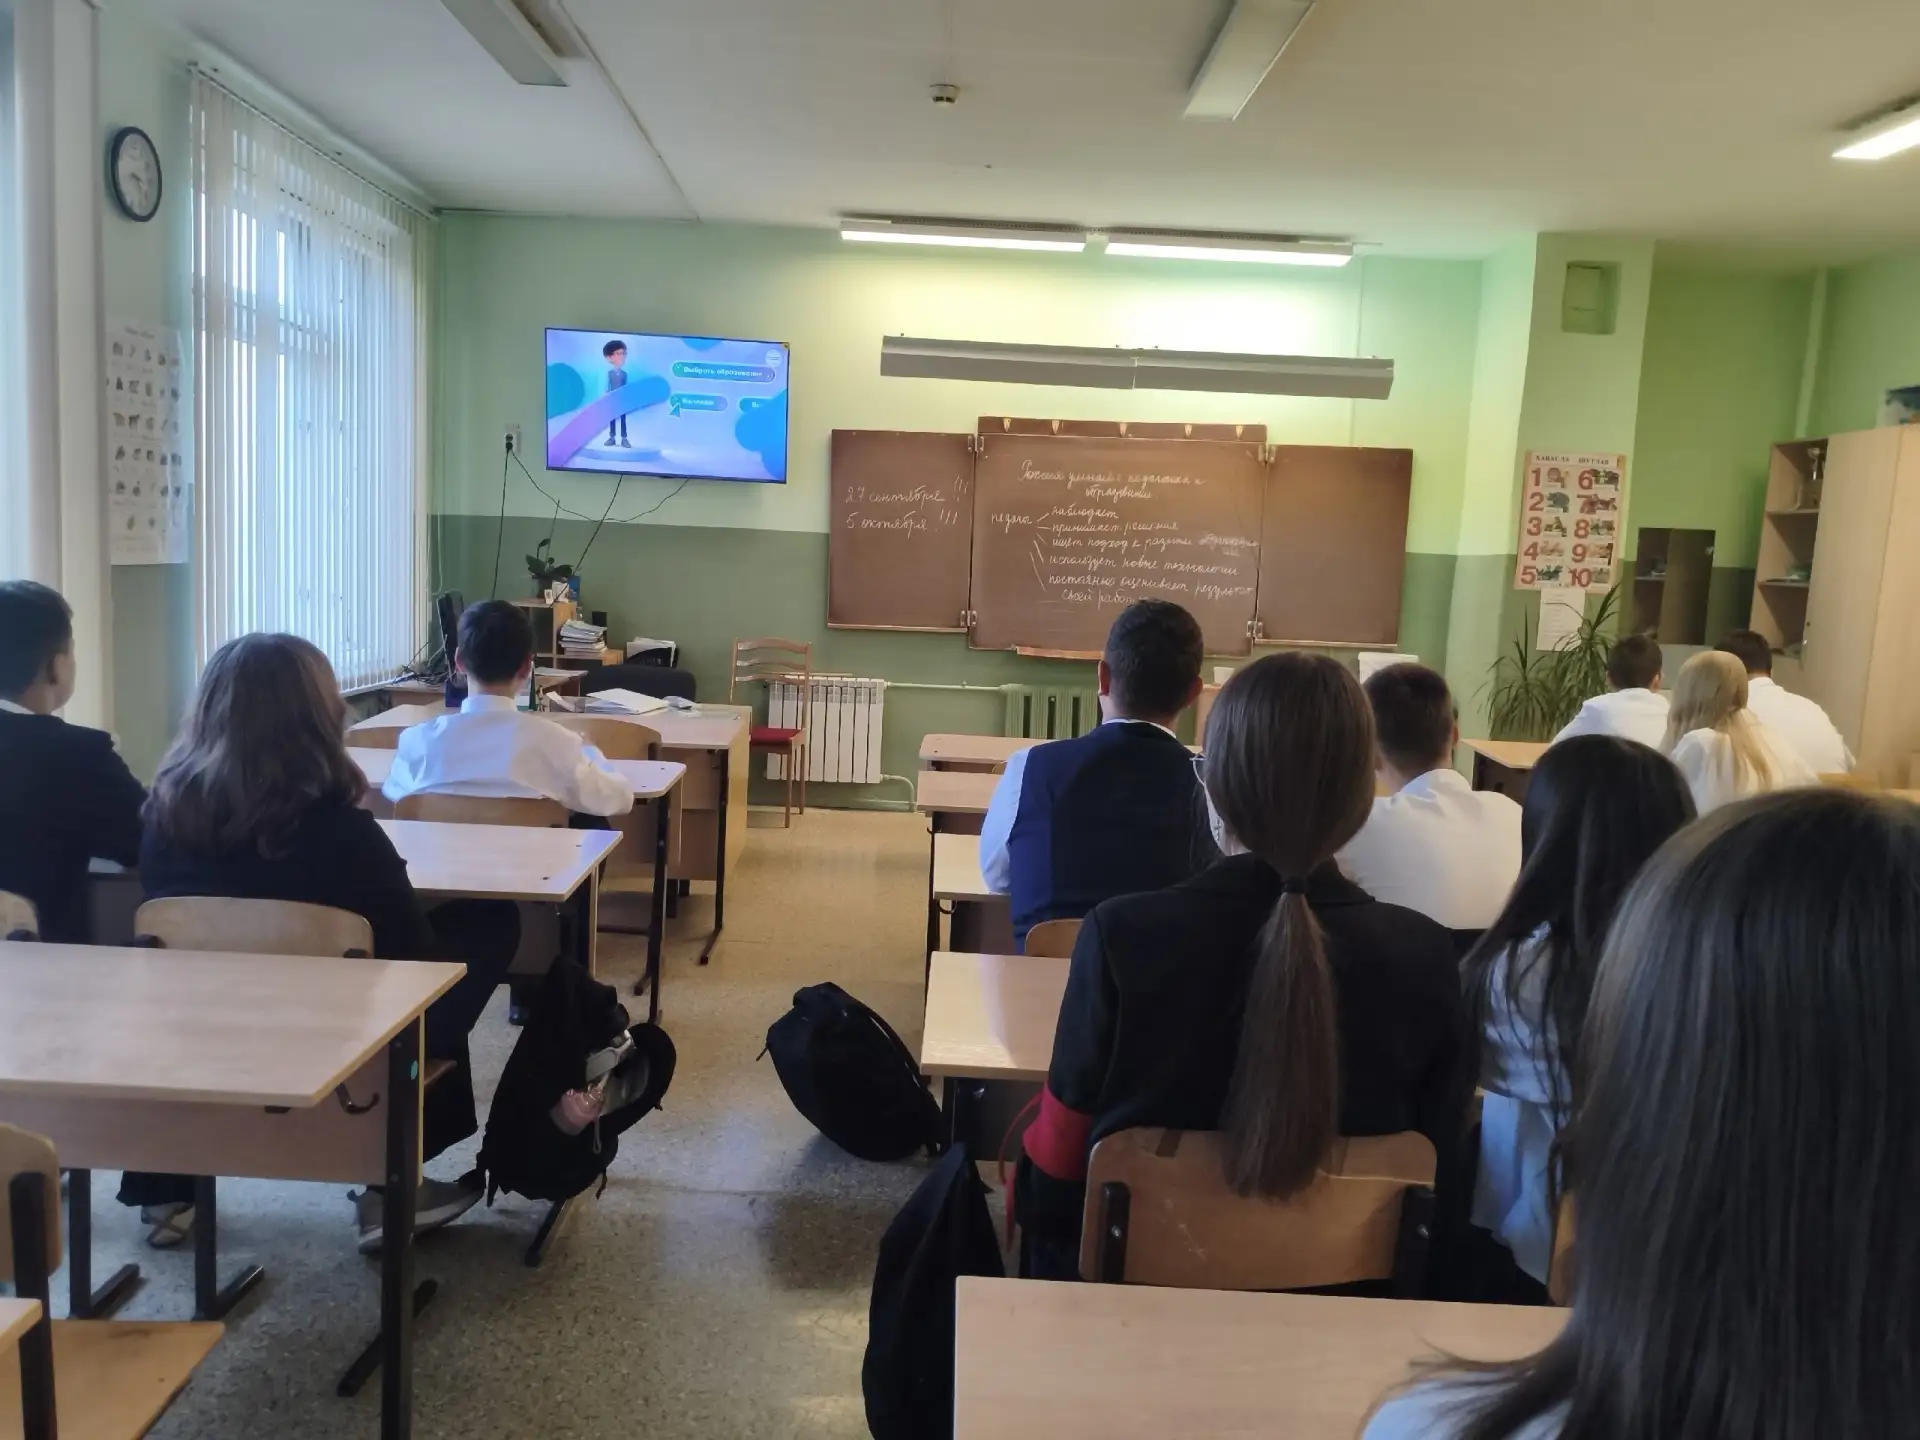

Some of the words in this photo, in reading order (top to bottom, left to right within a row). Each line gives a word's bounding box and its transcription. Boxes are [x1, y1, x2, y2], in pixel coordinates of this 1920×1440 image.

[1531, 467, 1541, 487] 1
[1578, 470, 1593, 490] 6
[845, 486, 865, 503] 27
[1529, 491, 1544, 511] 2
[1576, 494, 1597, 514] 7
[991, 512, 1033, 534] педагог
[1051, 503, 1119, 524] наблюдает
[846, 512, 859, 529] 5
[861, 510, 927, 540] октября
[1526, 516, 1542, 536] 3
[1574, 519, 1590, 539] 8
[1087, 538, 1128, 554] подход
[1523, 542, 1539, 560] 4
[1572, 543, 1587, 563] 9
[1520, 566, 1536, 585] 5
[1568, 568, 1592, 587] 10
[1061, 588, 1094, 603] своей
